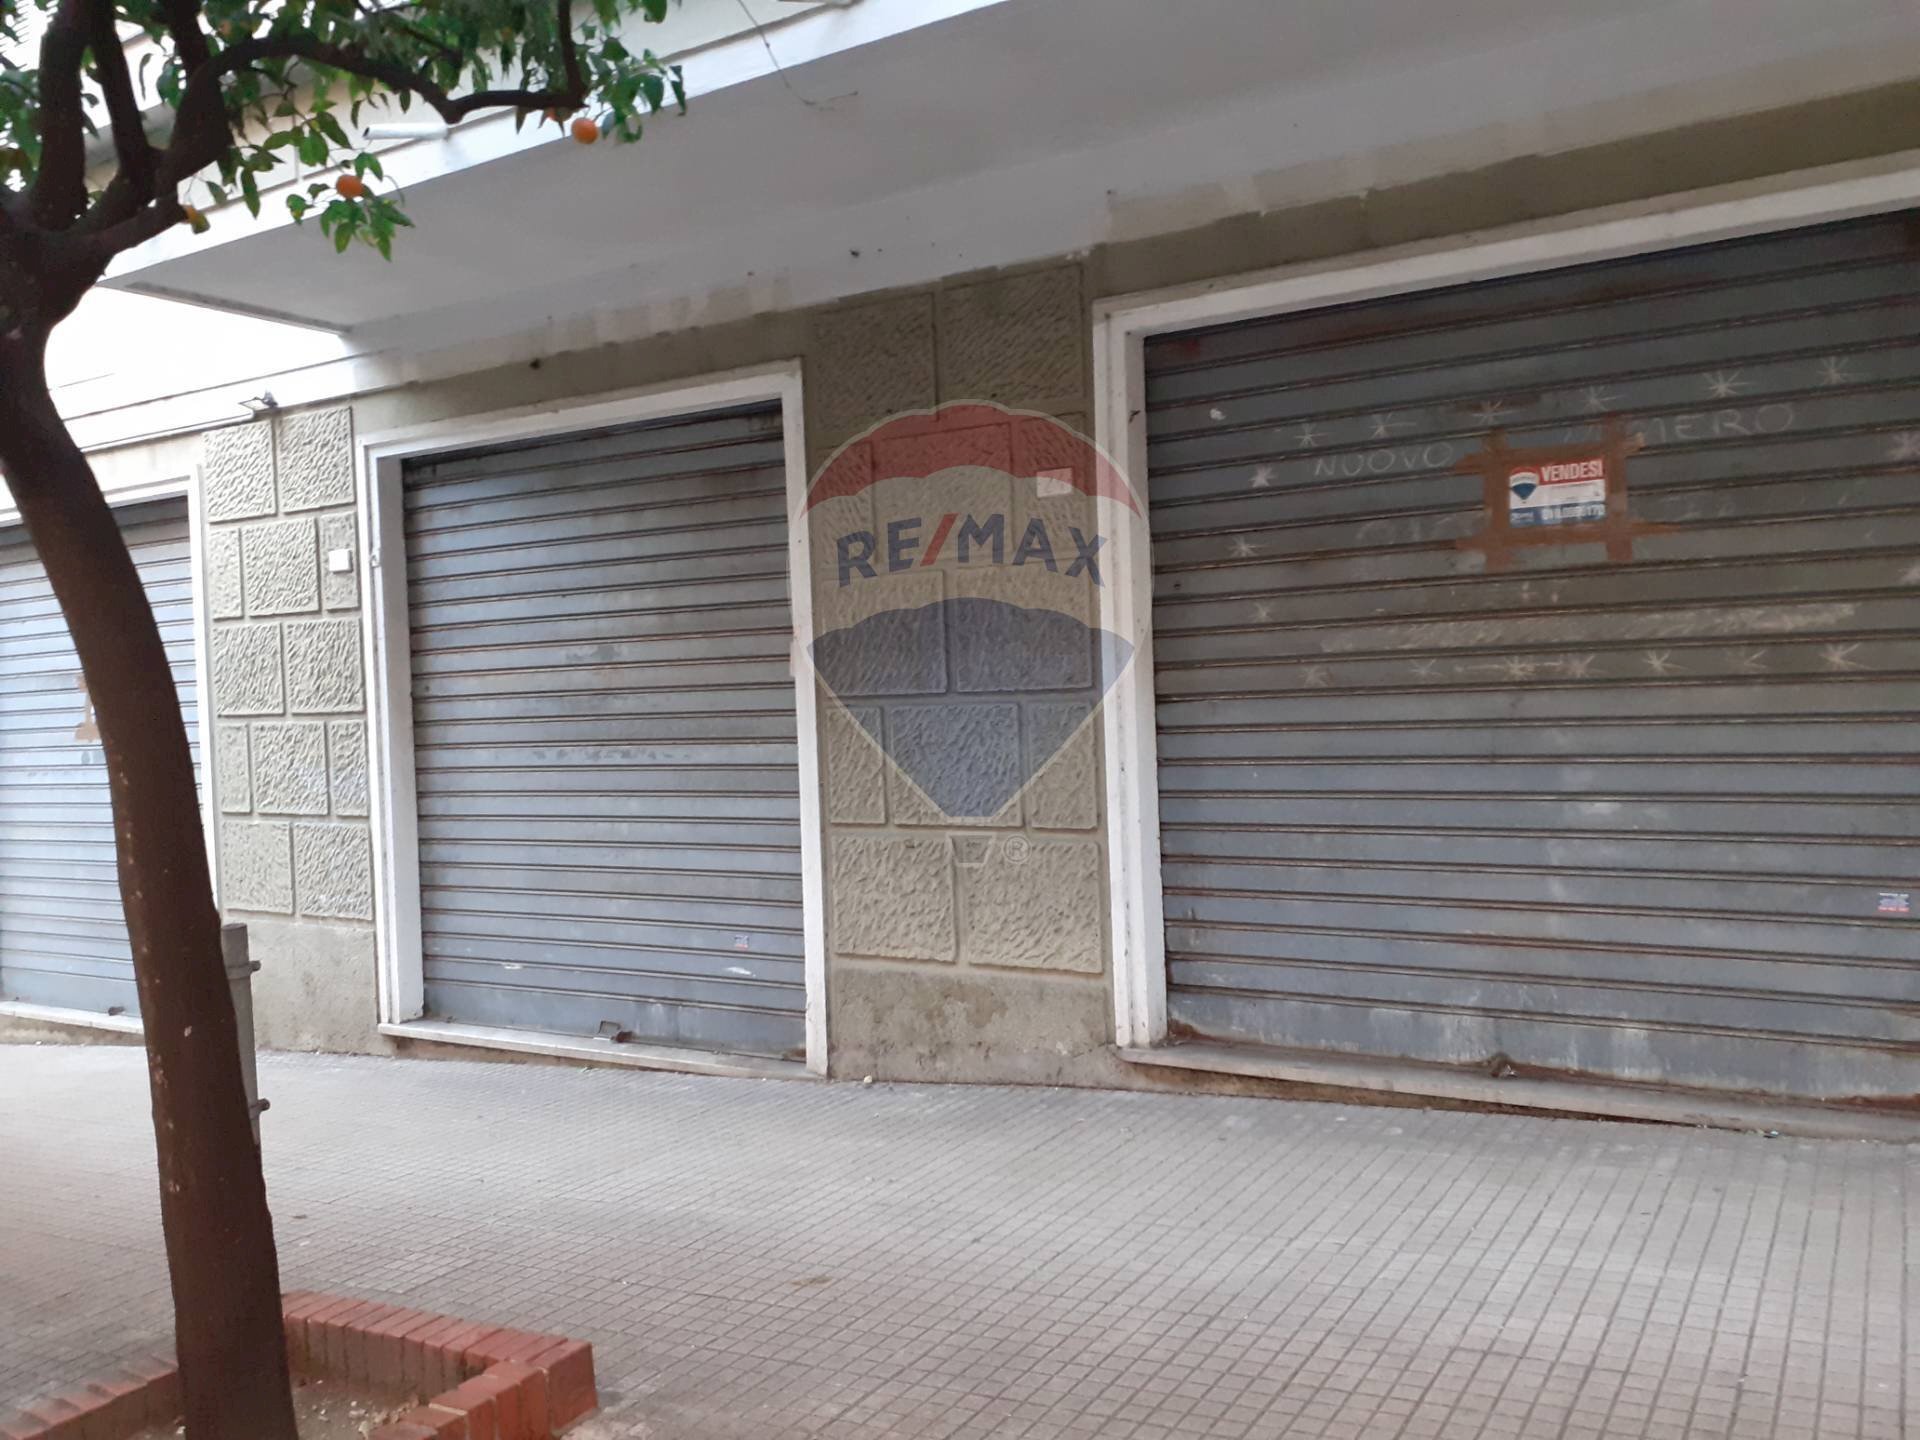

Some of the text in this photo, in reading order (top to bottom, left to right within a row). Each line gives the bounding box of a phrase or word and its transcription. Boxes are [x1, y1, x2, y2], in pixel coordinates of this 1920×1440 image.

[1315, 402, 1793, 476] NUOVO MERO
[1541, 459, 1603, 482] VENDESI
